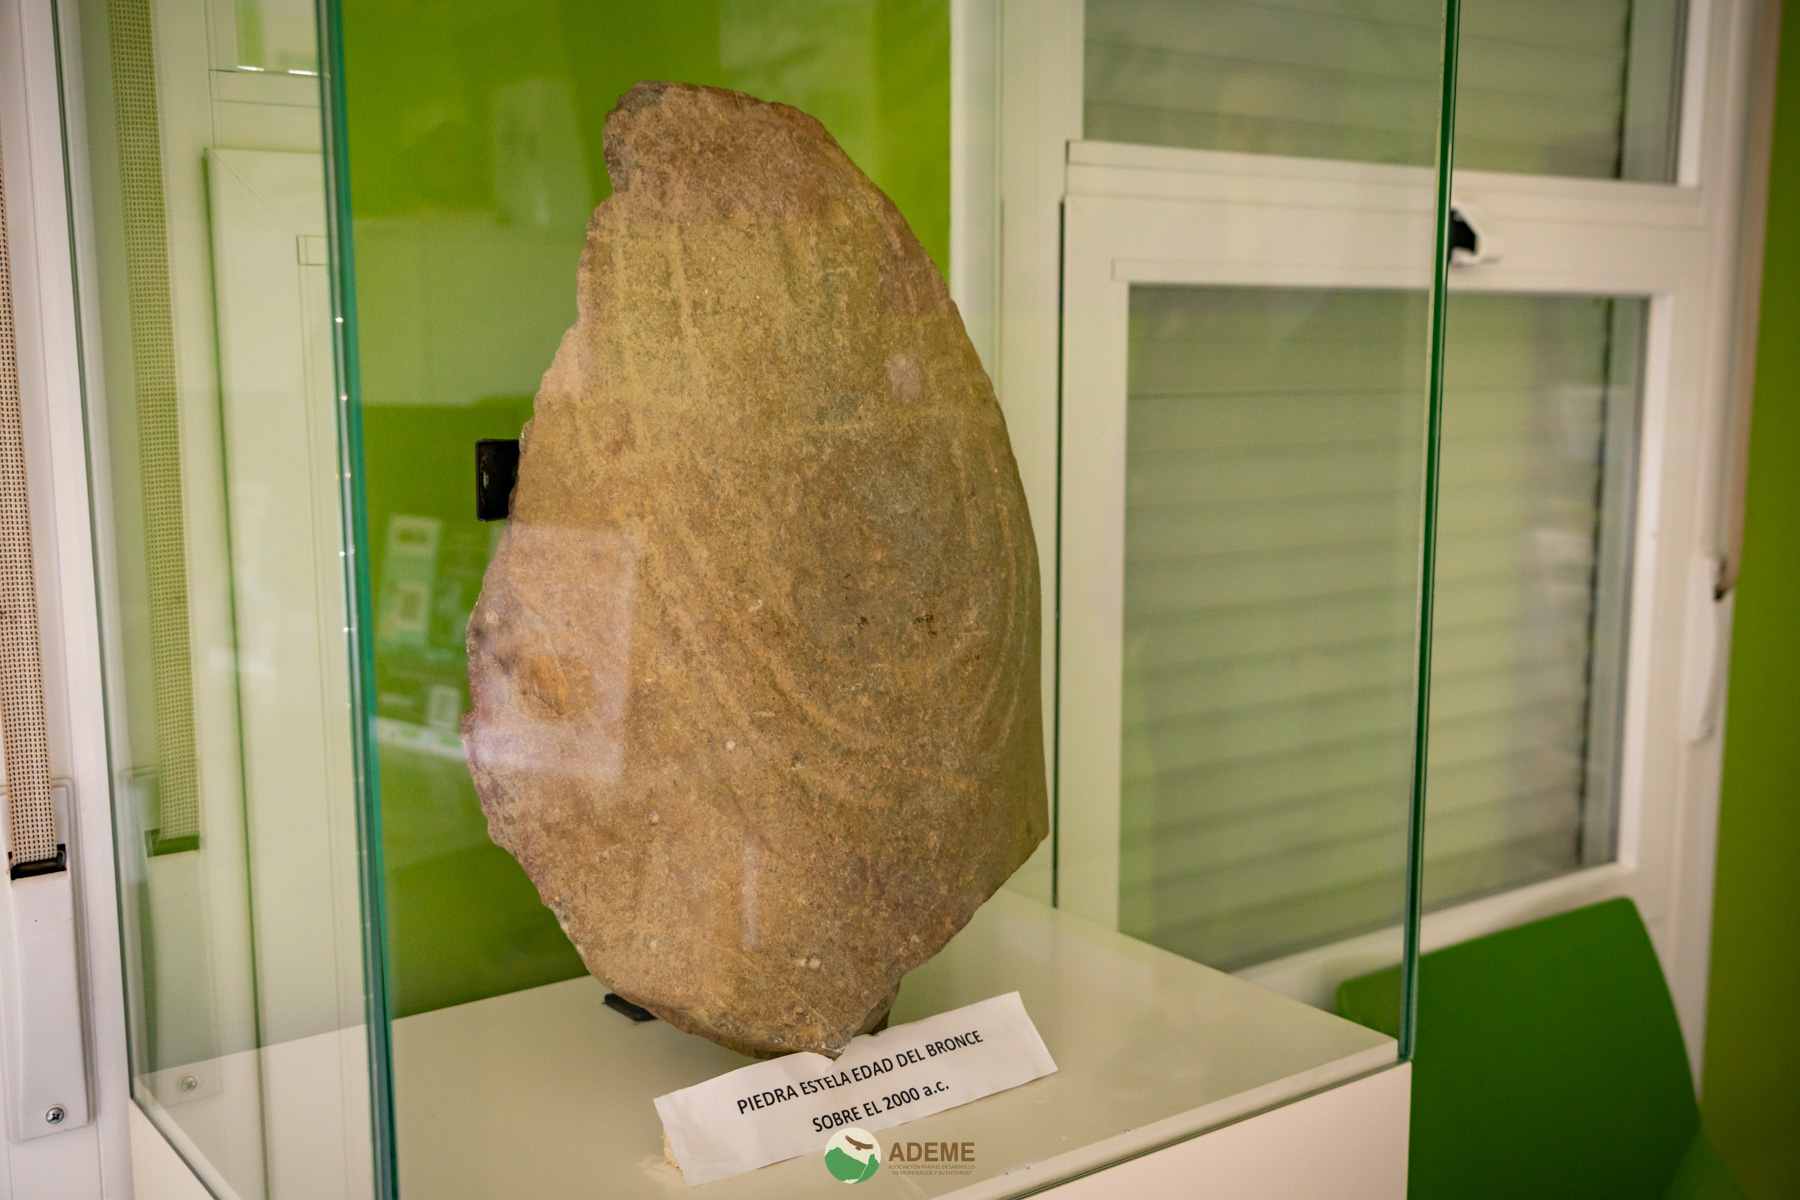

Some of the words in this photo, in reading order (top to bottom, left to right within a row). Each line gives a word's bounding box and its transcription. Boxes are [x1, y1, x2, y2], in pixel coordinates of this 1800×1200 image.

[736, 1085, 799, 1115] PIEDRA
[799, 1071, 851, 1096] ESTELA
[851, 1058, 894, 1082] EDAD
[896, 1048, 925, 1068] DEL
[925, 1030, 983, 1058] BRONCE
[812, 1107, 862, 1133] SOBRE
[863, 1100, 882, 1117] EL
[882, 1087, 921, 1111] 2000
[923, 1081, 950, 1097] a.c.
